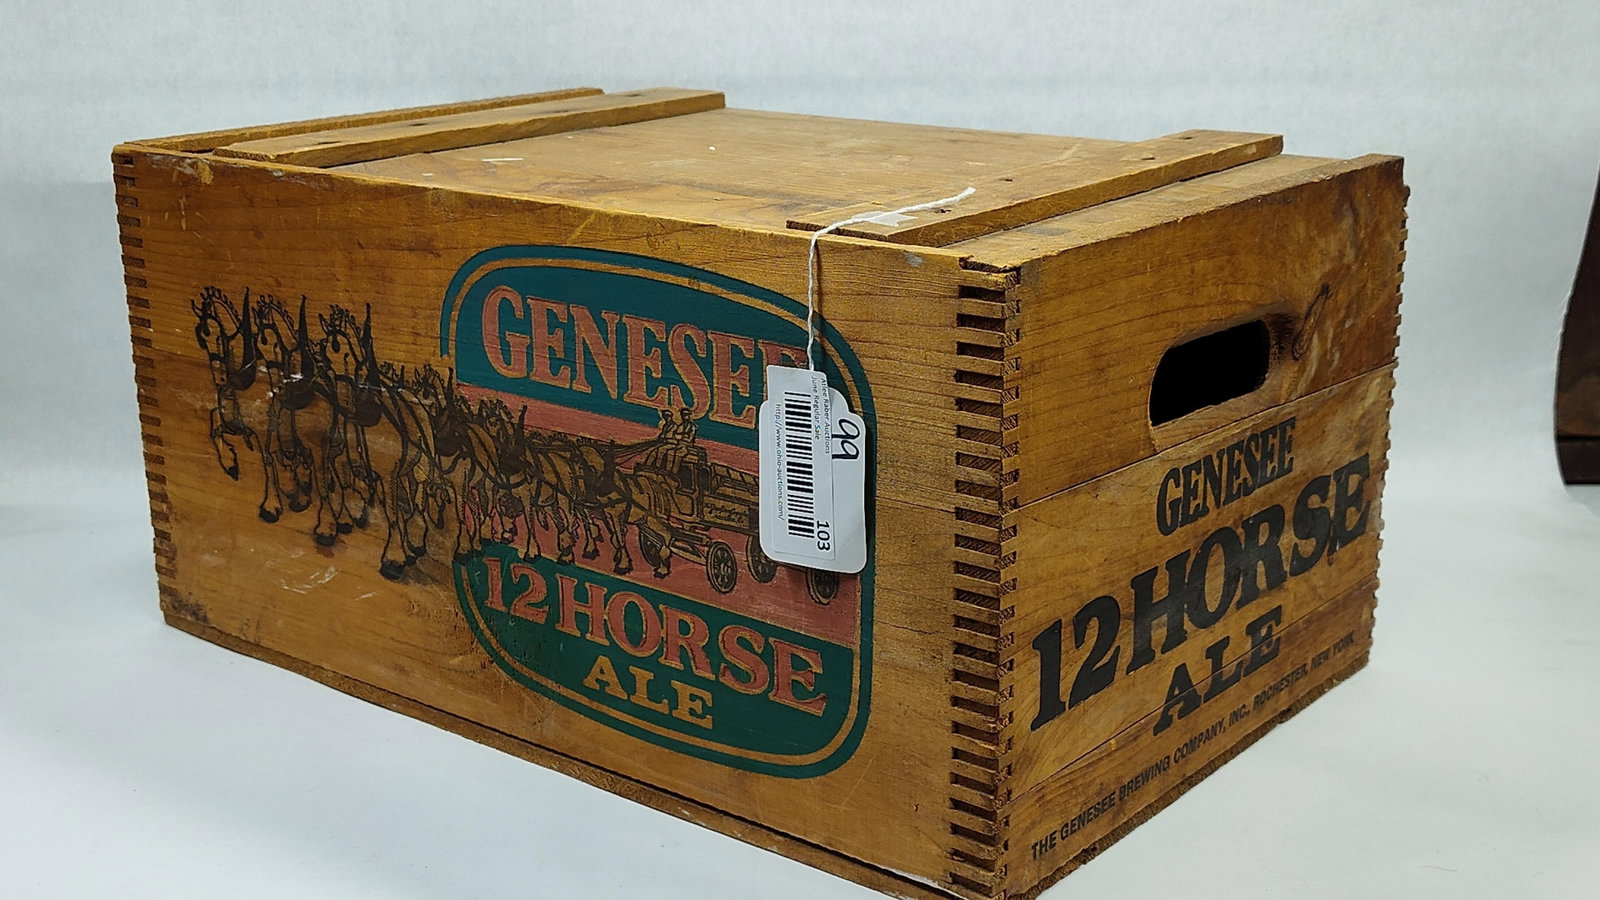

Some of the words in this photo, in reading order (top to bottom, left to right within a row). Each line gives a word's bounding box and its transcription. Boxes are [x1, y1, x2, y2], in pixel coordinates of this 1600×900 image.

[775, 403, 785, 521] http://www.ohio-auctions.com/
[812, 395, 820, 423] Regular
[832, 418, 860, 460] 99
[816, 520, 831, 551] 103
[1156, 416, 1296, 536] GENESEE
[483, 557, 549, 624] 12
[554, 572, 828, 717] HORSE
[1030, 596, 1121, 732] 12
[1126, 453, 1370, 676] HORSE
[583, 655, 713, 730] ALE
[1153, 605, 1282, 736] ALE
[1031, 830, 1057, 861] THE
[1060, 792, 1116, 842] GENESEE
[1119, 755, 1170, 801] BREWING
[1173, 718, 1226, 764] COMPANY,
[1310, 648, 1331, 672] NEW
[1333, 632, 1355, 653] YORK
